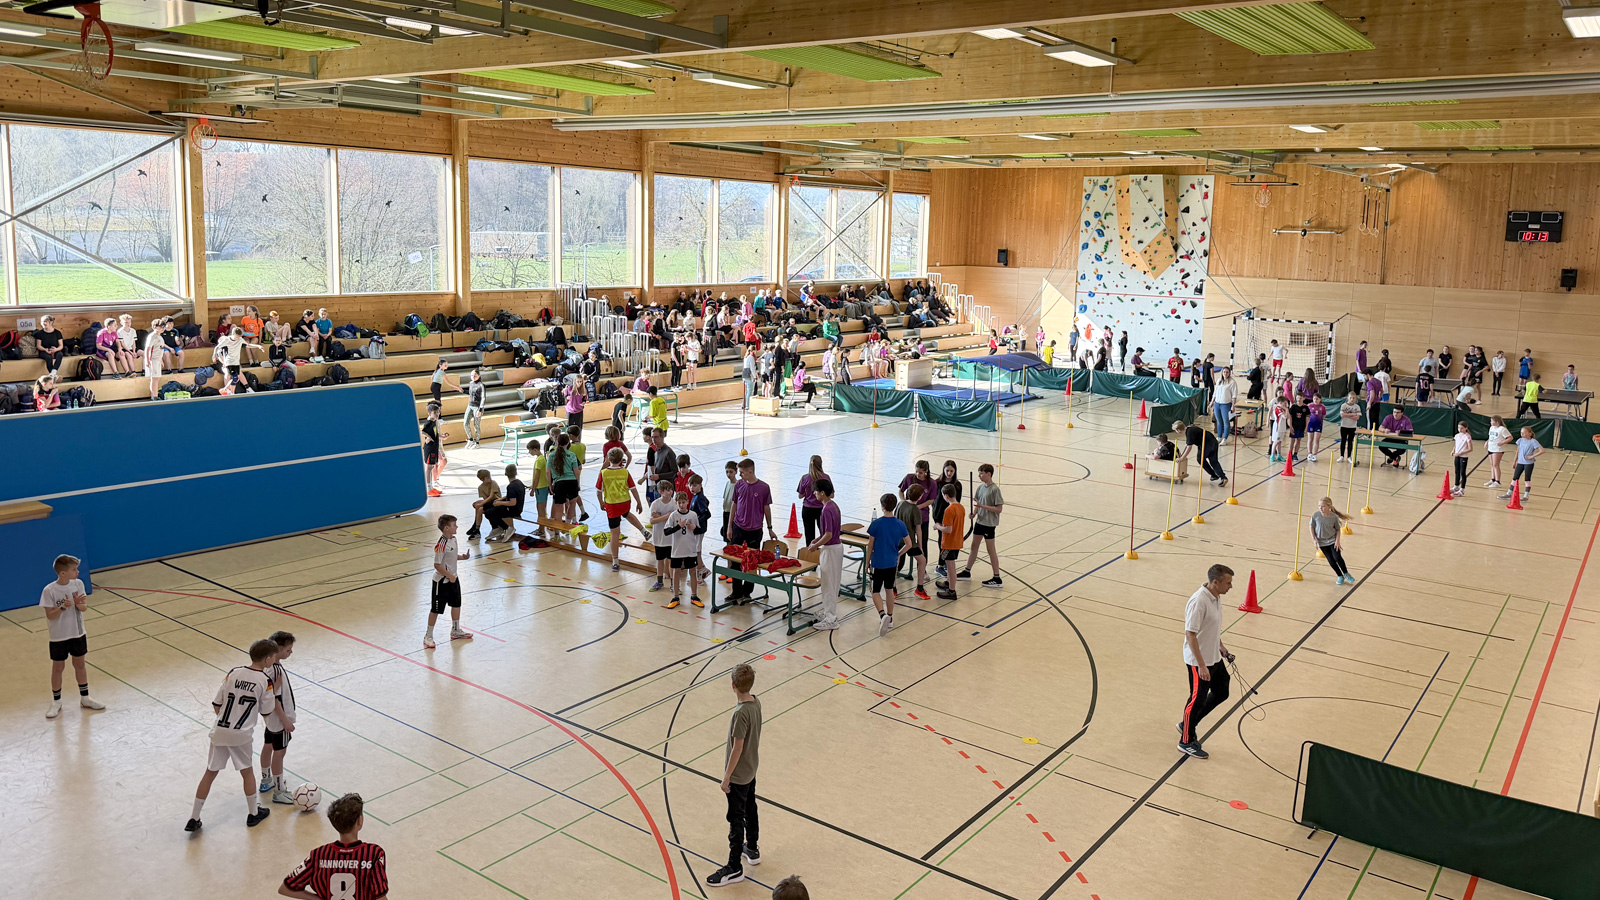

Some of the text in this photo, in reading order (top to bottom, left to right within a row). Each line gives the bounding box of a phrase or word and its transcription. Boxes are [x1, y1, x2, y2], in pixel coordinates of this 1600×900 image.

[1522, 231, 1549, 242] 10:13
[1420, 379, 1430, 390] 10
[682, 526, 686, 536] 8
[235, 678, 256, 692] WIRTZ
[217, 692, 258, 730] 17
[319, 860, 372, 870] HANNOVER 96
